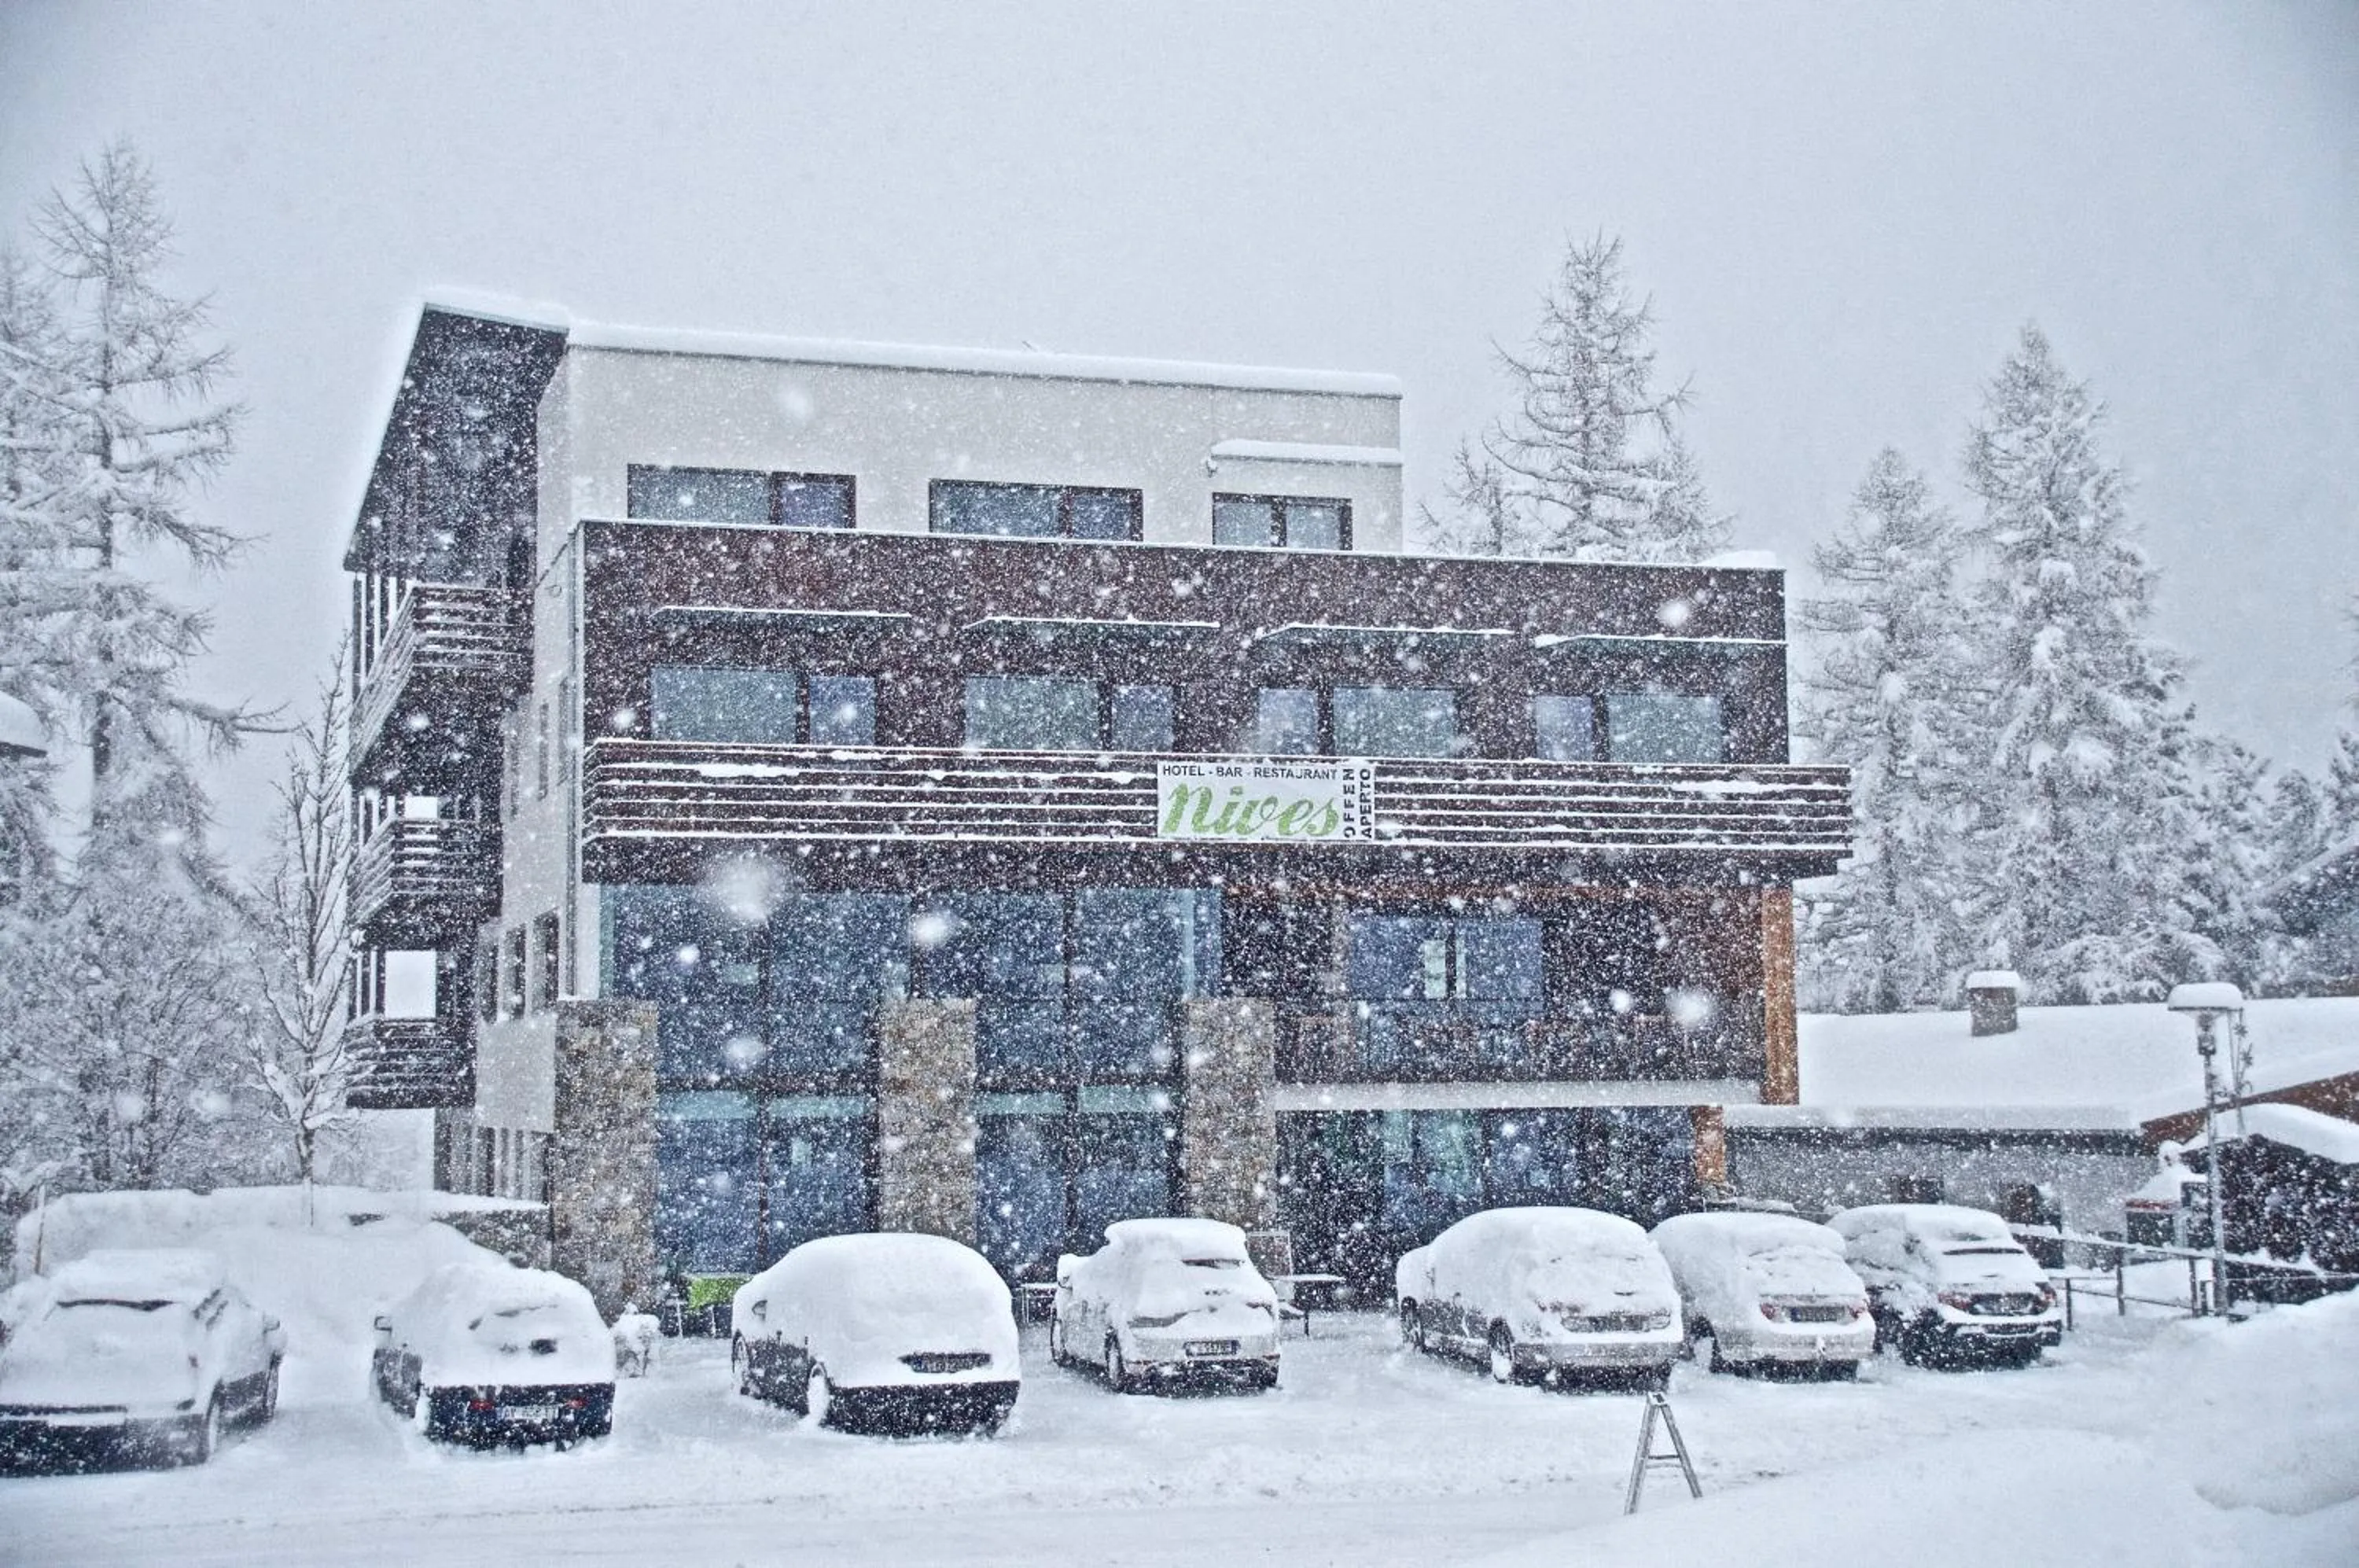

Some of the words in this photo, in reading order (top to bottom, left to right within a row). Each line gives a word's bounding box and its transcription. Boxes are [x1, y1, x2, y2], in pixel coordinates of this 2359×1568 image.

[1162, 764, 1205, 777] HOTEL
[1217, 767, 1242, 778] BAR
[1253, 767, 1337, 780] RESTAURANT
[1343, 768, 1356, 838] OFFEN
[1360, 768, 1372, 838] APERTO
